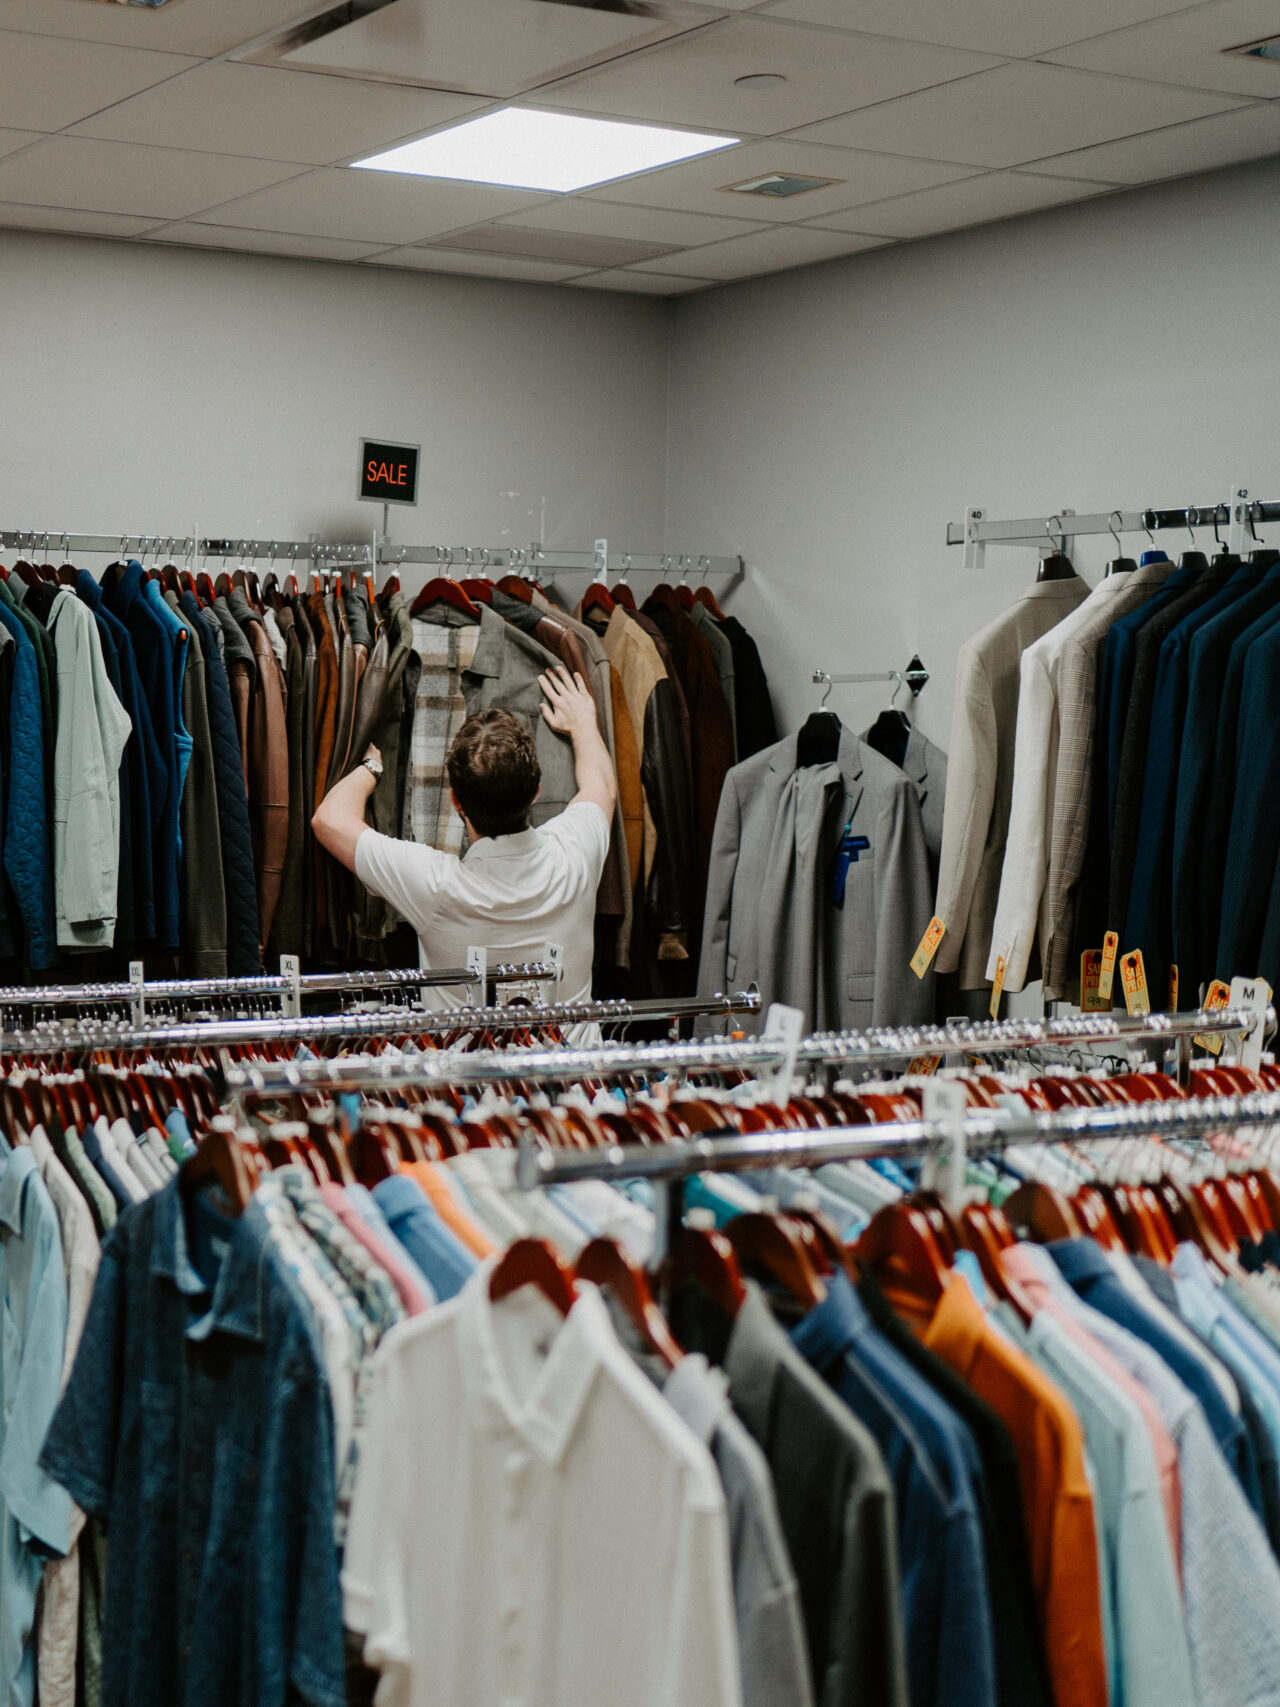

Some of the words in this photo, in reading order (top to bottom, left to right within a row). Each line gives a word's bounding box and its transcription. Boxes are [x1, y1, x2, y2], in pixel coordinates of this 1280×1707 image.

[366, 460, 408, 486] SALE
[1237, 489, 1248, 498] 42
[971, 510, 982, 520] 40
[474, 951, 480, 961] L
[550, 948, 558, 959] M
[285, 960, 294, 970] XL
[1087, 962, 1102, 975] SAL
[1243, 986, 1255, 1001] M
